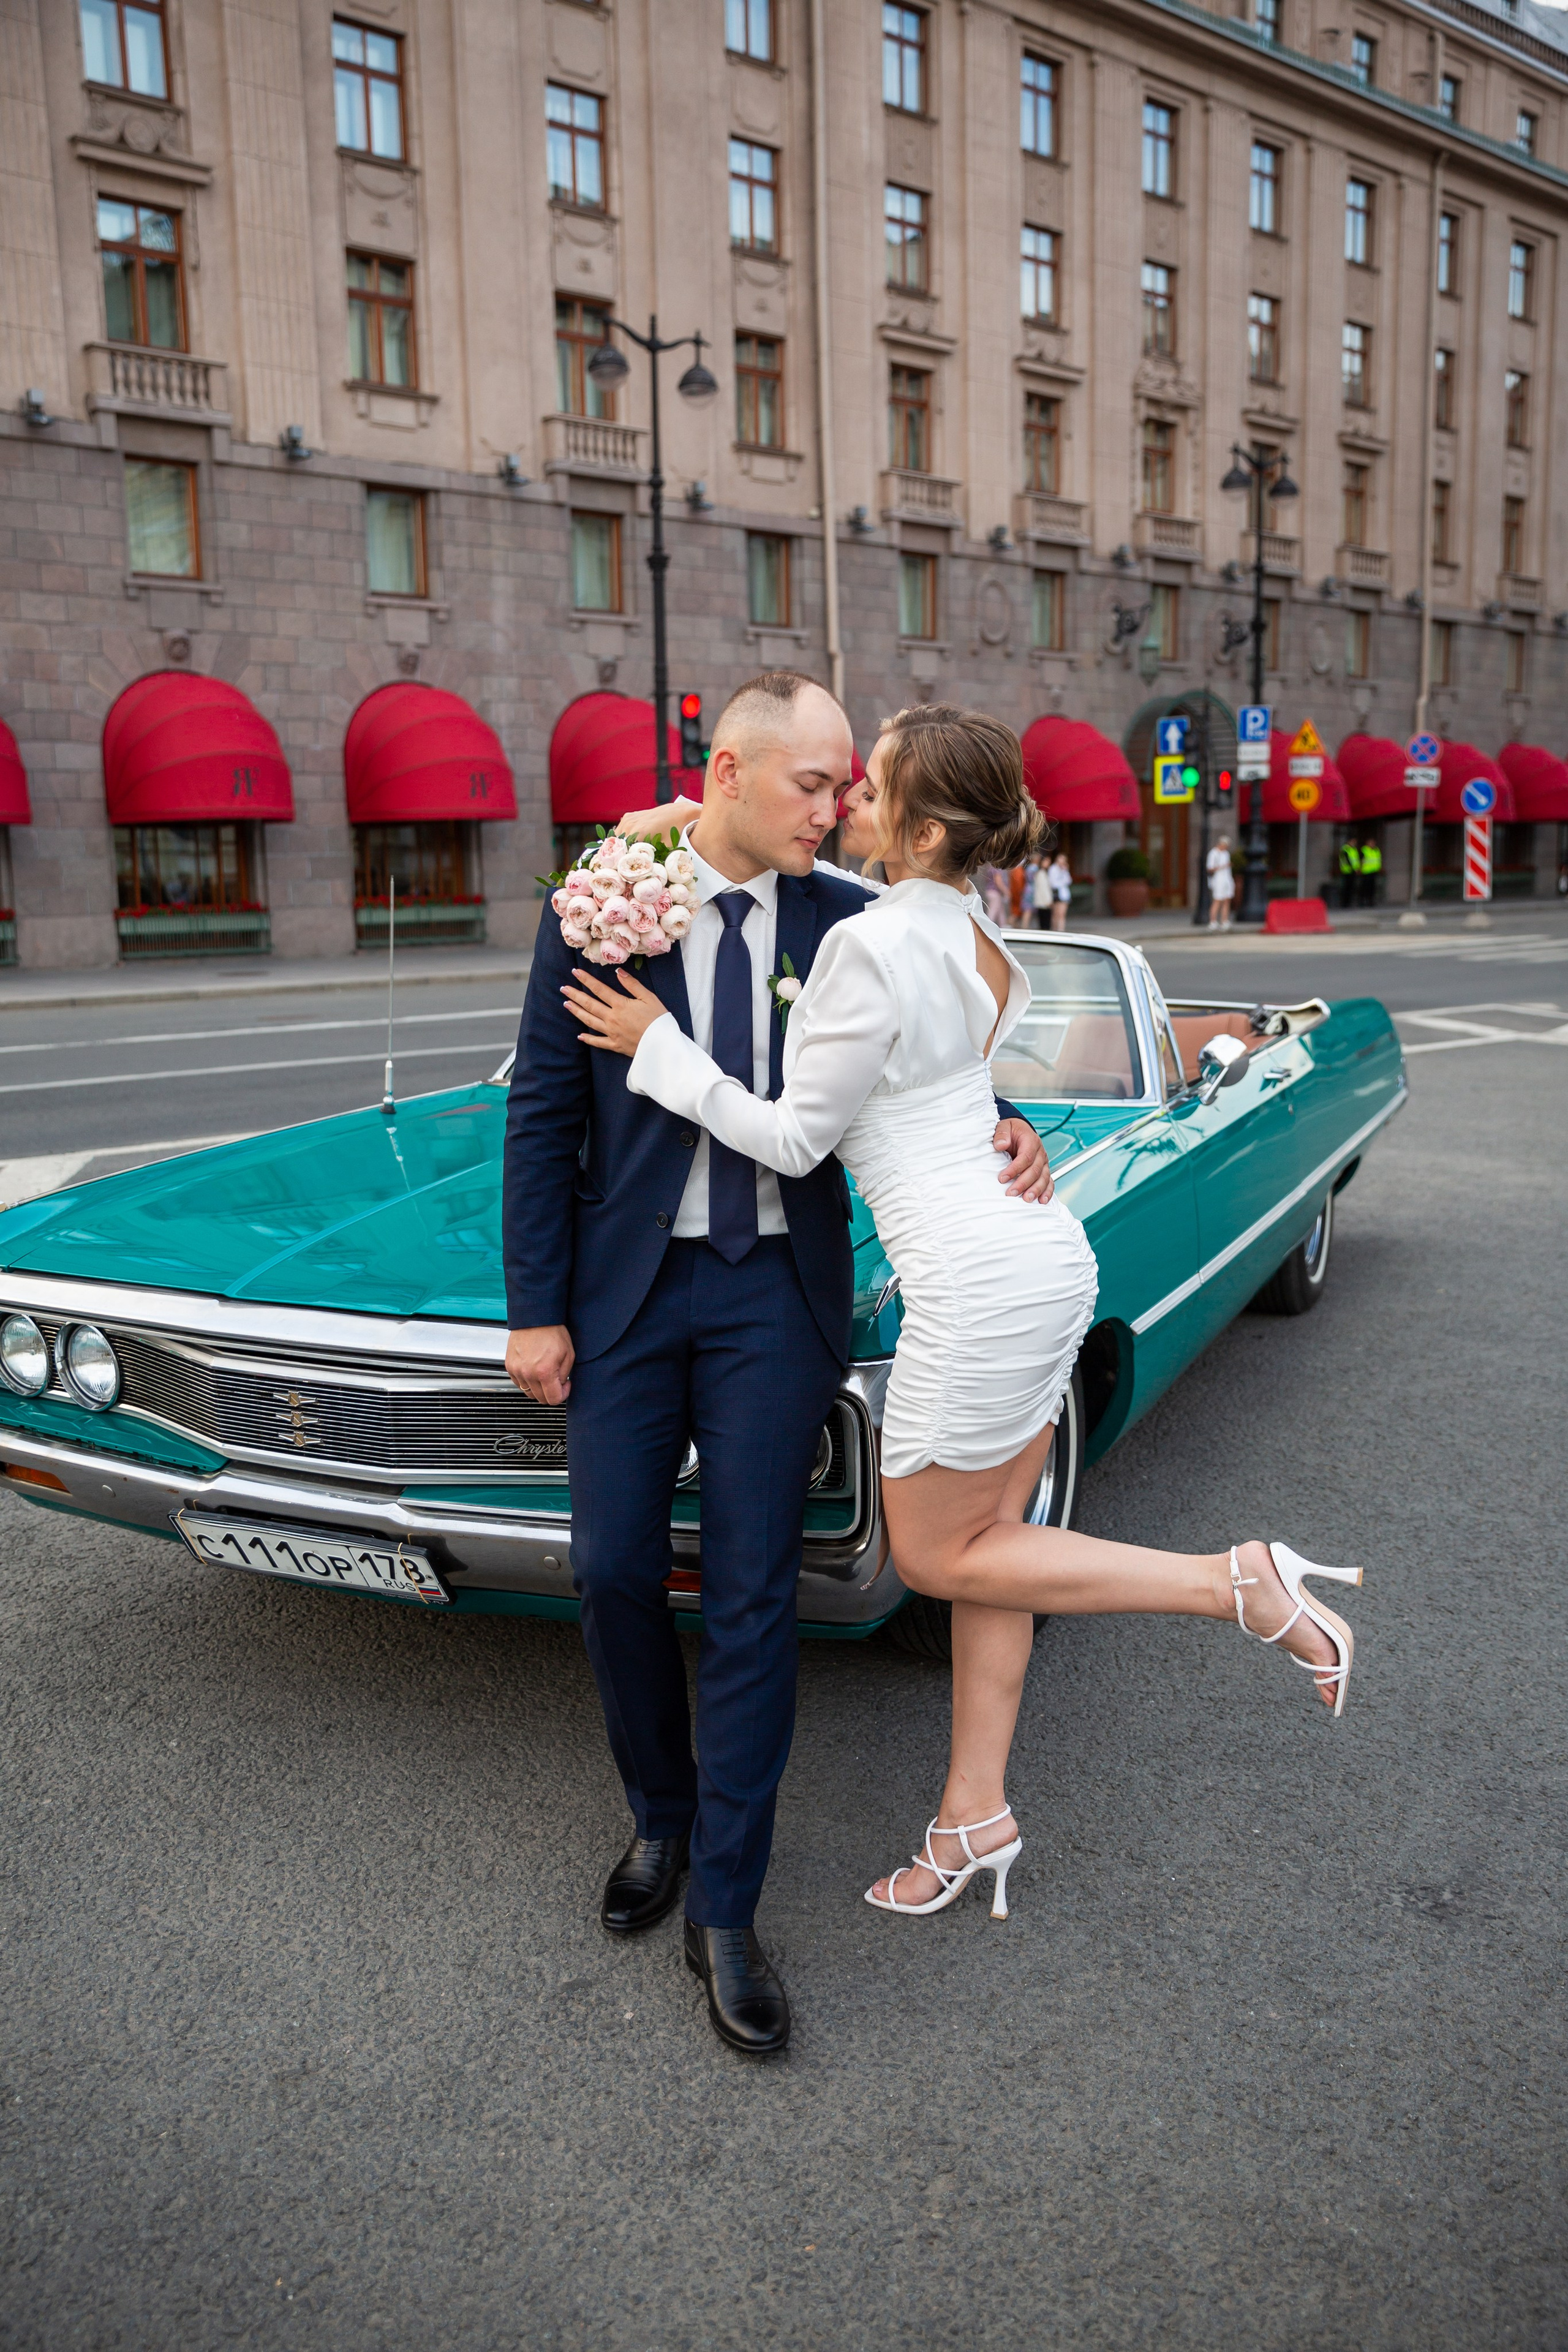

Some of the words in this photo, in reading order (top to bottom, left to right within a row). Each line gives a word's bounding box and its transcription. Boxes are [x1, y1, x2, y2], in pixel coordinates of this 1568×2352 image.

[494, 1435, 567, 1460] Chrysle
[358, 1551, 425, 1584] 178
[383, 1579, 417, 1592] RUS
